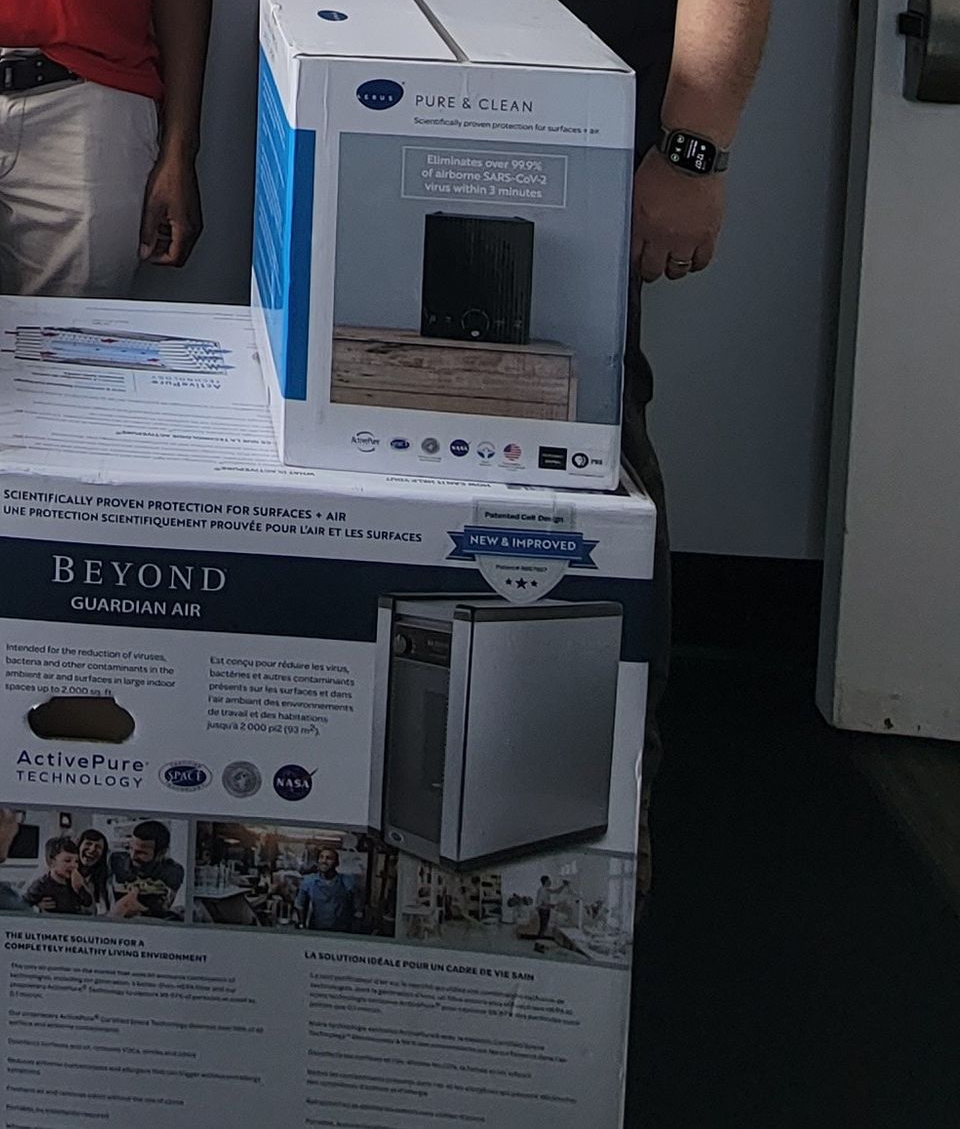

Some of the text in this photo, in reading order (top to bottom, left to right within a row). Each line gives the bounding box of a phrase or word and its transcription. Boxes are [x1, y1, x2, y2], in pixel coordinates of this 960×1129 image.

[415, 95, 533, 112] PURE & CLEAN
[414, 116, 462, 128] Scientifically
[463, 120, 491, 129] proven
[492, 121, 533, 132] protection
[548, 125, 581, 134] surfaces
[427, 154, 542, 171] Eliminates over 99.9%
[421, 169, 547, 185] of airborne SARS-CoV-2
[424, 182, 542, 198] virus within 3 minutes
[3, 489, 347, 522] SCIENTIFICALLY PROVEN PROTECTION FOR SURFACES + AIR
[3, 505, 422, 543] UNE PROTECTION SCIENTIFIQUEMENT PROUVÉE POUR L'AIR ET LES SURFACES
[470, 536, 576, 551] NEW & IMPROVED
[51, 554, 226, 593] BEYOND
[70, 596, 201, 617] GUARDIAN AIR
[6, 644, 46, 653] Intended
[48, 646, 60, 654] for
[62, 647, 77, 655] the
[78, 648, 121, 658] reduction
[16, 770, 143, 789] TECHNOLOGY
[275, 778, 310, 789] NASA
